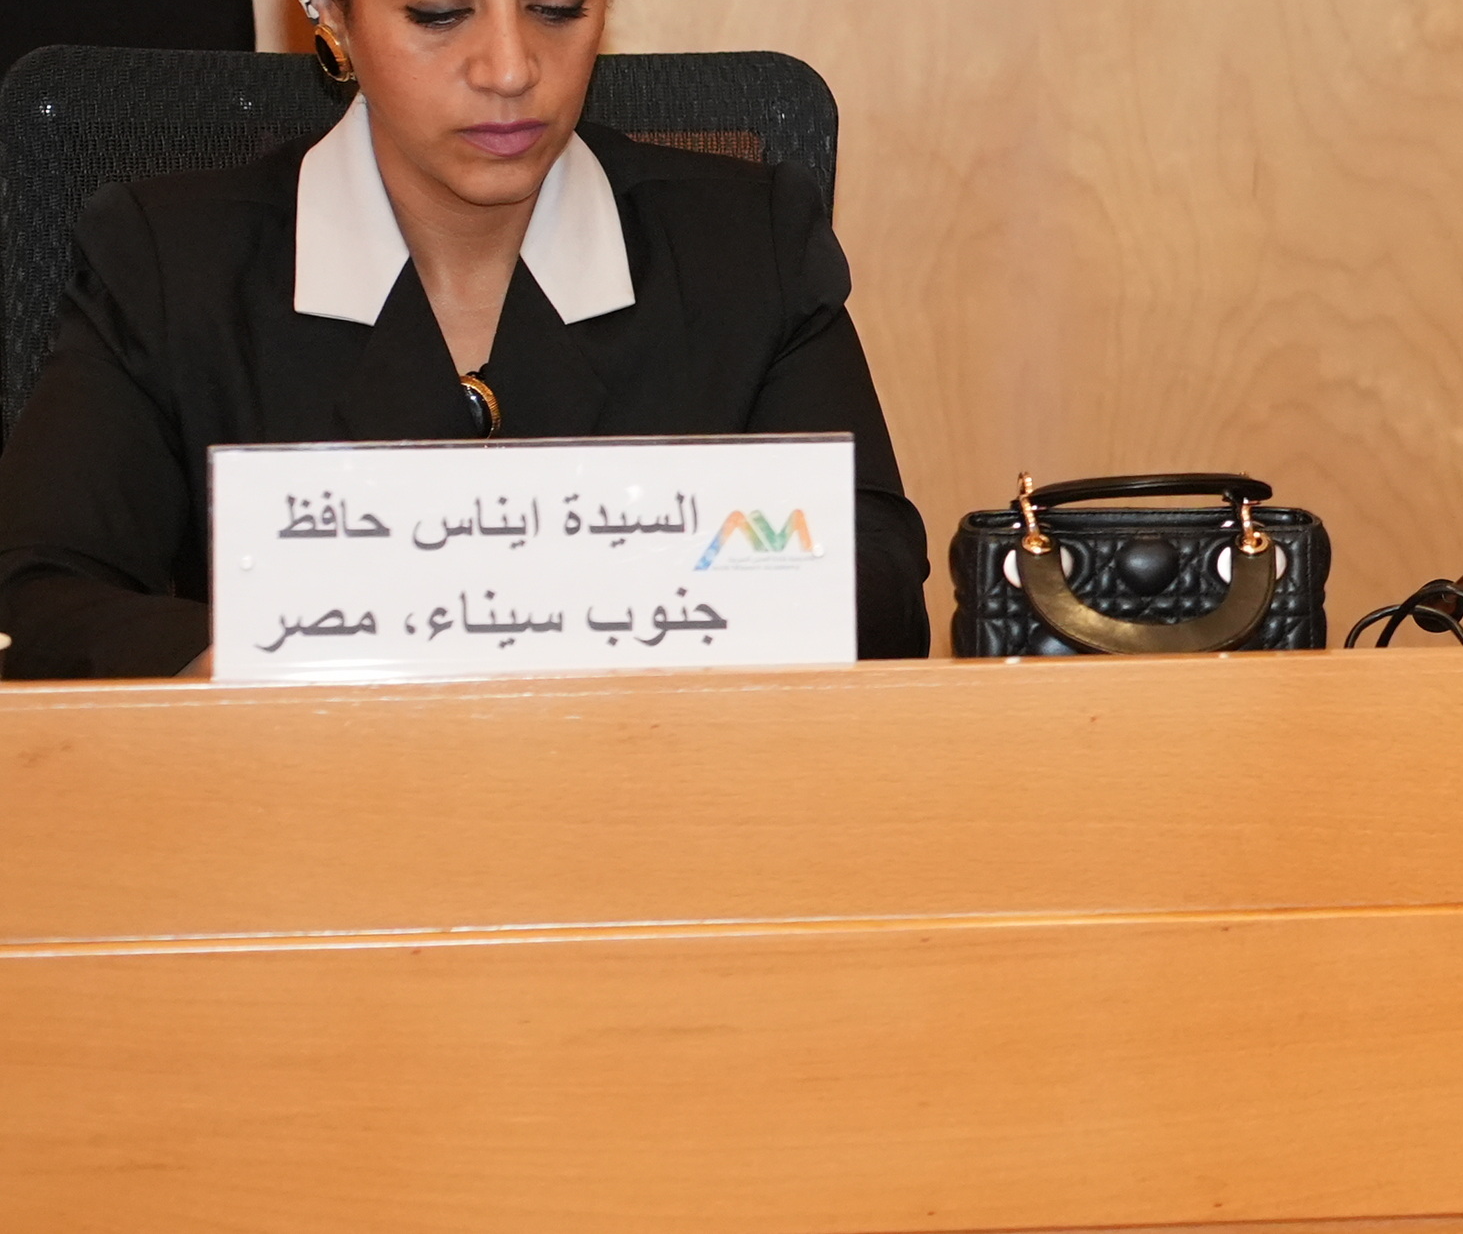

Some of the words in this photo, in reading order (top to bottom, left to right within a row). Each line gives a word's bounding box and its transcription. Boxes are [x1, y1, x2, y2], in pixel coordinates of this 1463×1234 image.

[278, 490, 391, 539] حافظ
[412, 496, 540, 551] ايناس
[563, 492, 698, 548] السيدة
[257, 608, 378, 654] مصر
[404, 589, 564, 649] سيناء،
[586, 587, 728, 647] جنوب
